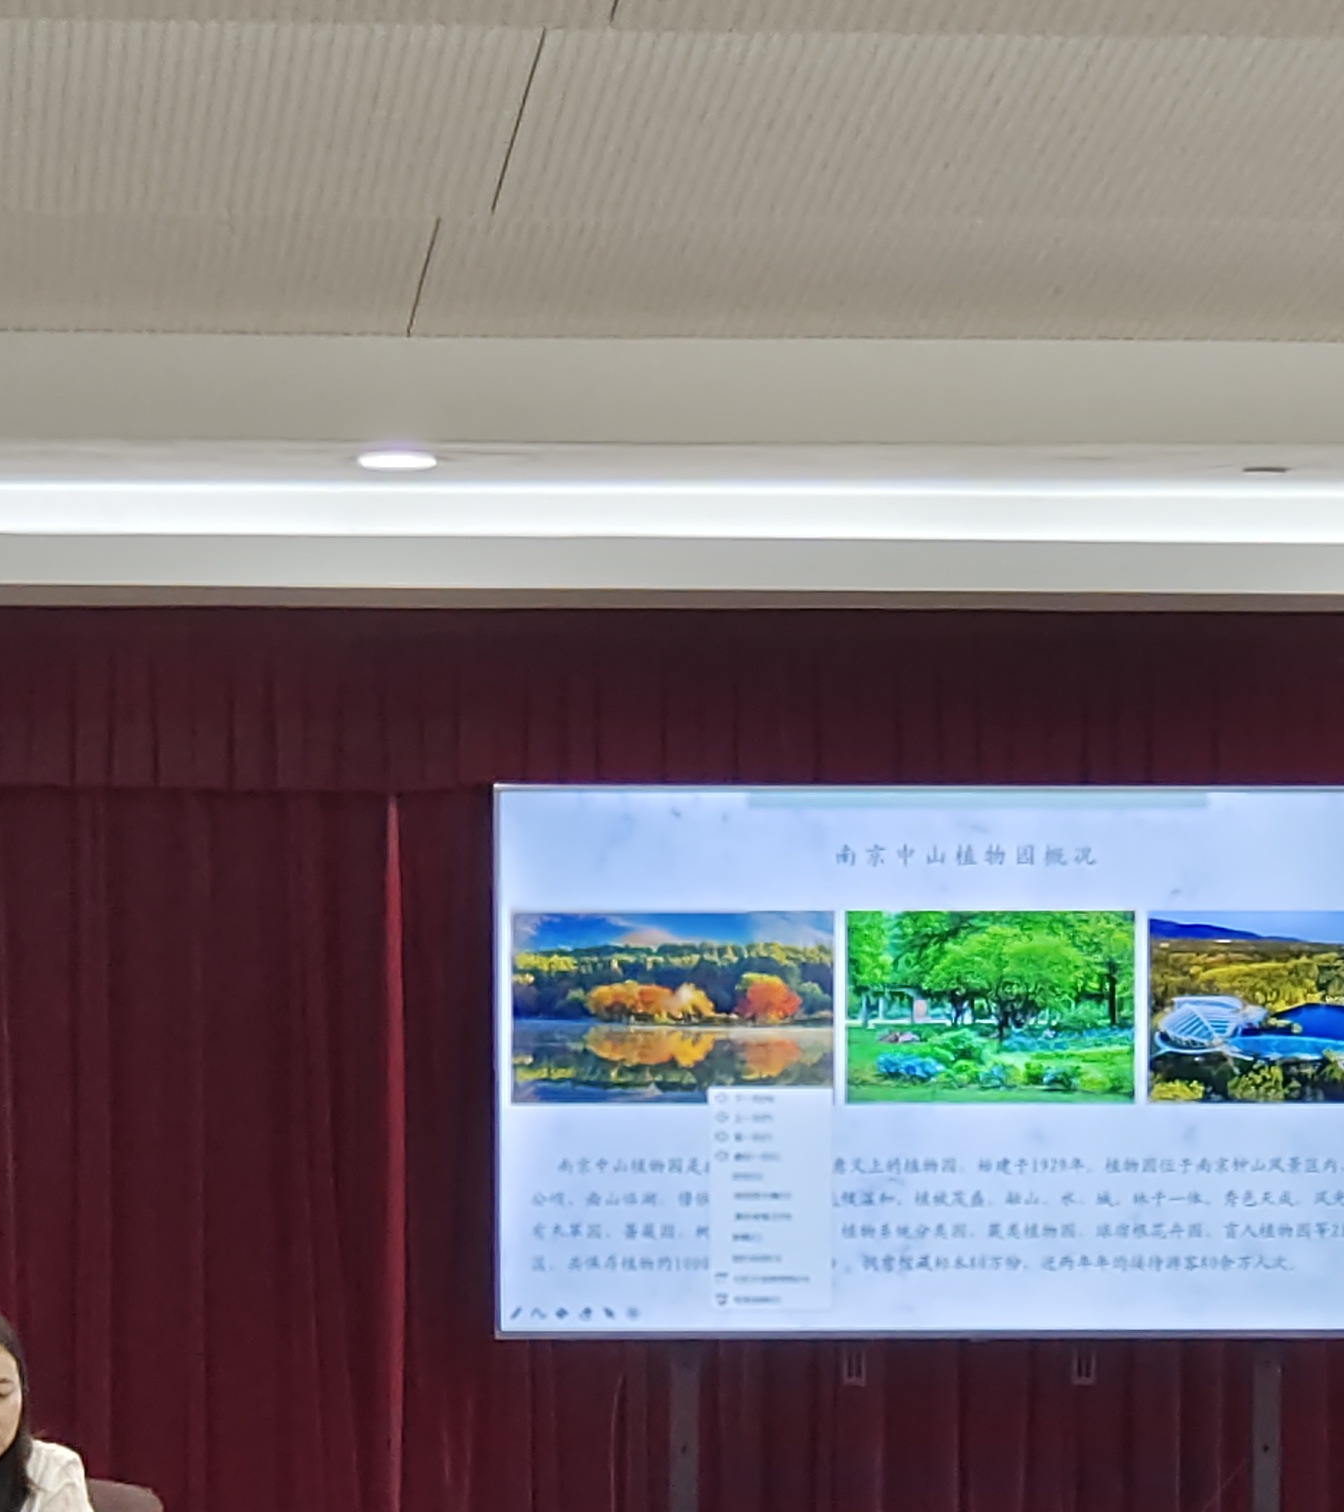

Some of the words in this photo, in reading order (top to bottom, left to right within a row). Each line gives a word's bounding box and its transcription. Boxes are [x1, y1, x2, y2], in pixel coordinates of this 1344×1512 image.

[835, 843, 1098, 867] 南京中山植物园概况
